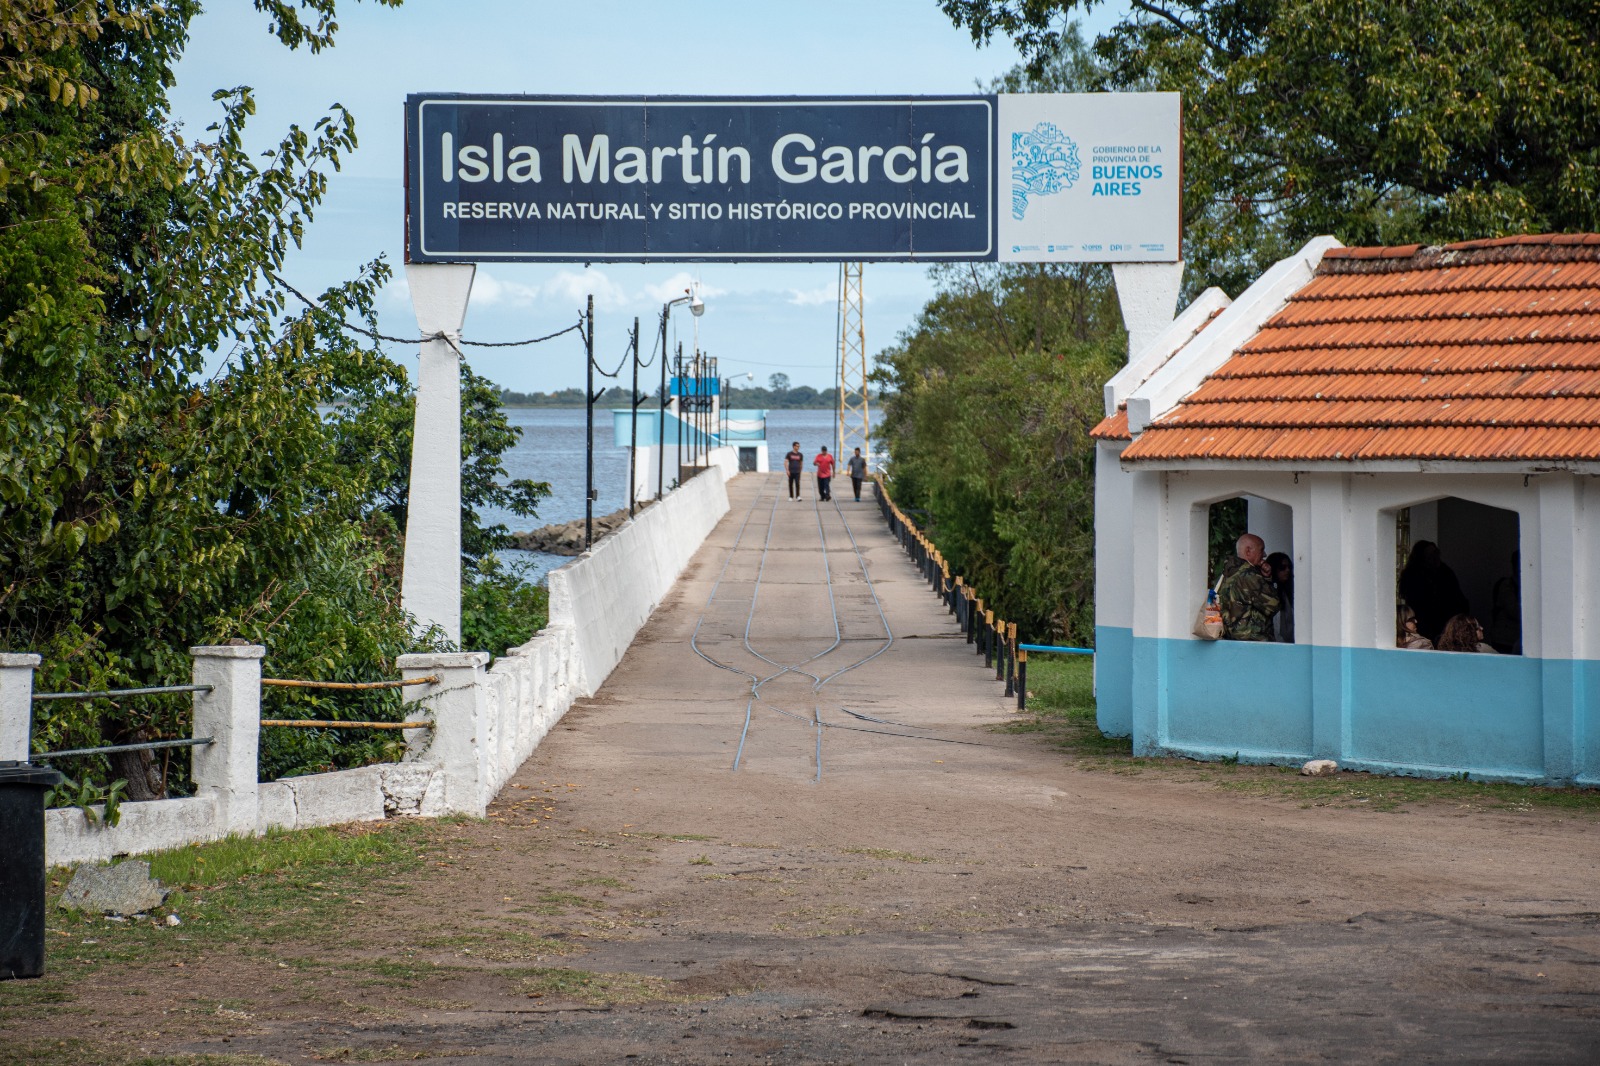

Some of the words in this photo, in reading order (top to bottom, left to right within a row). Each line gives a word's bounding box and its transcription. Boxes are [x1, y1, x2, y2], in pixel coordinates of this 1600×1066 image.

[1092, 146, 1136, 154] GOBIERNO
[1137, 146, 1149, 154] DE
[441, 131, 542, 183] Isla
[562, 133, 751, 184] Martín
[771, 132, 970, 184] García
[1092, 155, 1137, 163] PROVINCIA
[1139, 155, 1150, 163] DE
[1092, 165, 1163, 180] BUENOS
[1091, 182, 1142, 196] AIRES
[443, 202, 542, 219] RESERVA
[547, 202, 646, 220] NATURAL
[650, 203, 664, 220] Y
[668, 203, 723, 220] SITIO
[728, 199, 843, 220] HISTÓRICO
[848, 202, 976, 220] PROVINCIAL
